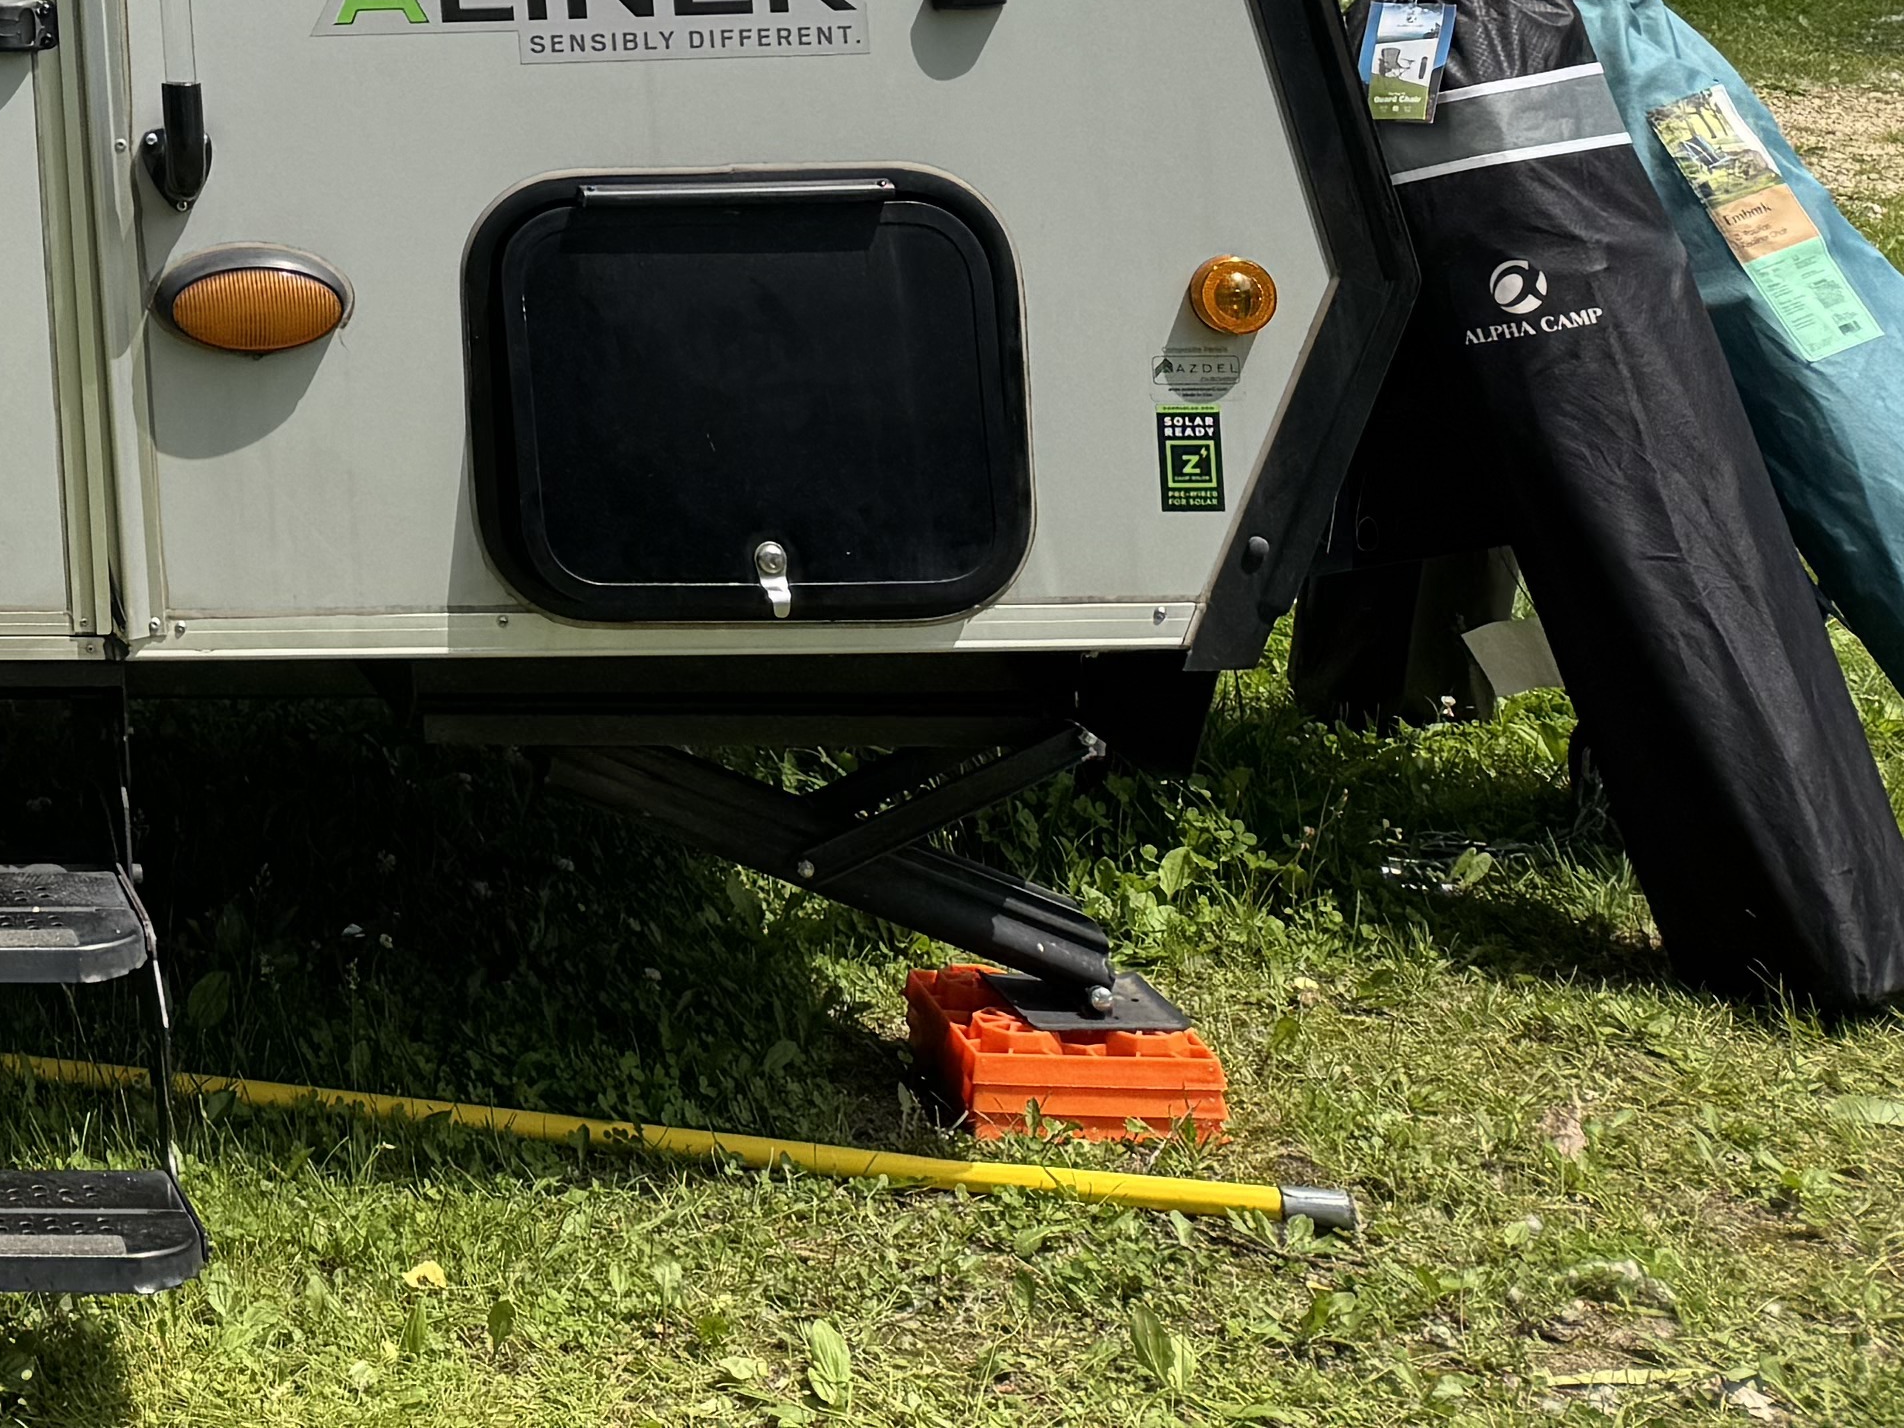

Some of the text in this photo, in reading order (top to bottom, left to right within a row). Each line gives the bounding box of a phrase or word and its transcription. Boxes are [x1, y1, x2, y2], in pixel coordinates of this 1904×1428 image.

[529, 24, 863, 54] SENSIBLY DIFFERENT.
[1465, 307, 1603, 345] ALPHA CAMP
[1176, 363, 1238, 373] AZDEL
[1163, 416, 1214, 426] SOLAR
[1163, 427, 1214, 437] READY
[1182, 455, 1201, 474] Z
[1168, 498, 1218, 506] FOR SOLAR
